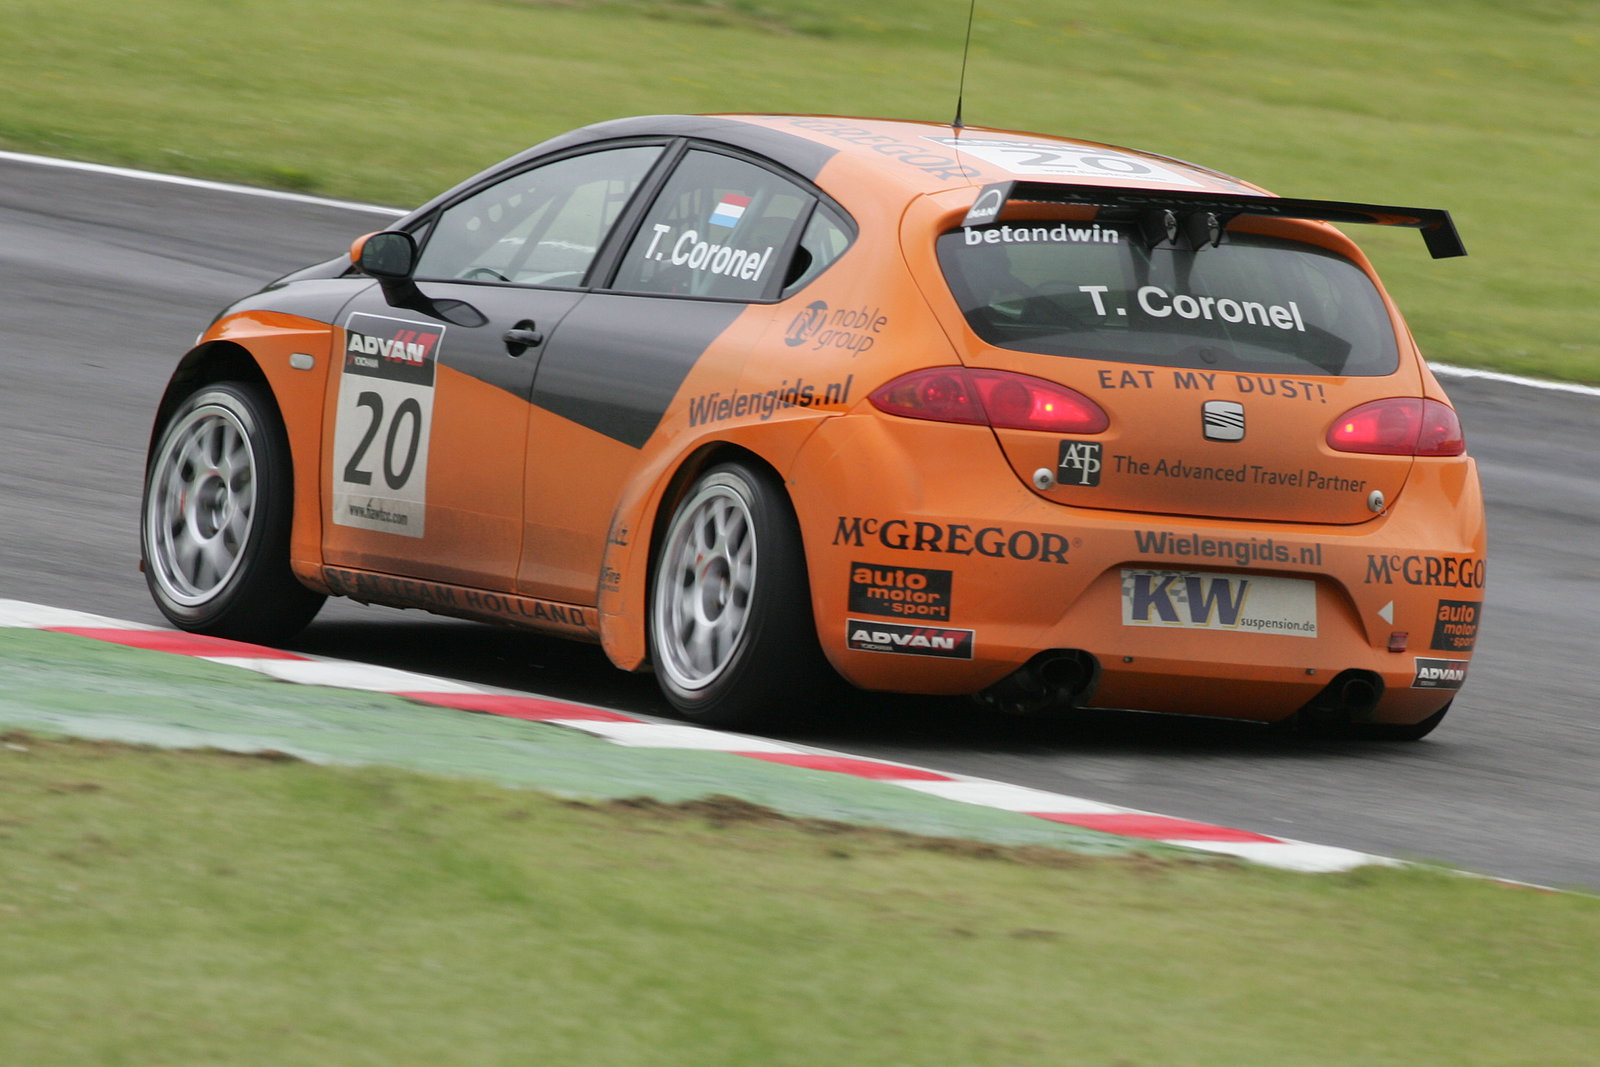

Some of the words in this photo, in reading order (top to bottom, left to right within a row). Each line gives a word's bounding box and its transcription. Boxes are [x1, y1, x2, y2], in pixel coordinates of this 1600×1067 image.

[1000, 150, 1152, 174] 20
[964, 224, 1120, 246] betandwin
[645, 223, 671, 262] T.
[672, 229, 774, 282] Coronel
[829, 305, 888, 333] noble
[1079, 284, 1127, 316] T.
[1137, 285, 1306, 332] Coronel
[348, 333, 425, 362] ADVAN
[812, 329, 874, 358] group
[688, 374, 855, 428] Wielengids.nl
[1097, 370, 1155, 389] EAT
[1174, 371, 1217, 391] MY
[1237, 375, 1327, 404] DUST!
[343, 391, 422, 490] 20
[1113, 455, 1150, 475] The
[1153, 458, 1247, 482] Advanced
[1251, 465, 1303, 488] Travel
[1307, 470, 1367, 493] Partner
[1134, 529, 1323, 567] Wielengids.nl
[852, 566, 928, 590] auto
[1363, 554, 1486, 589] McGREGO
[384, 577, 458, 608] TEAM
[464, 589, 587, 627] HOLLAND
[866, 585, 941, 604] motor
[1131, 574, 1252, 629] KW
[1240, 617, 1315, 633] suspension.de
[1438, 605, 1476, 623] auto
[850, 629, 955, 650] ADVAN
[1418, 667, 1465, 682] ADVAN
